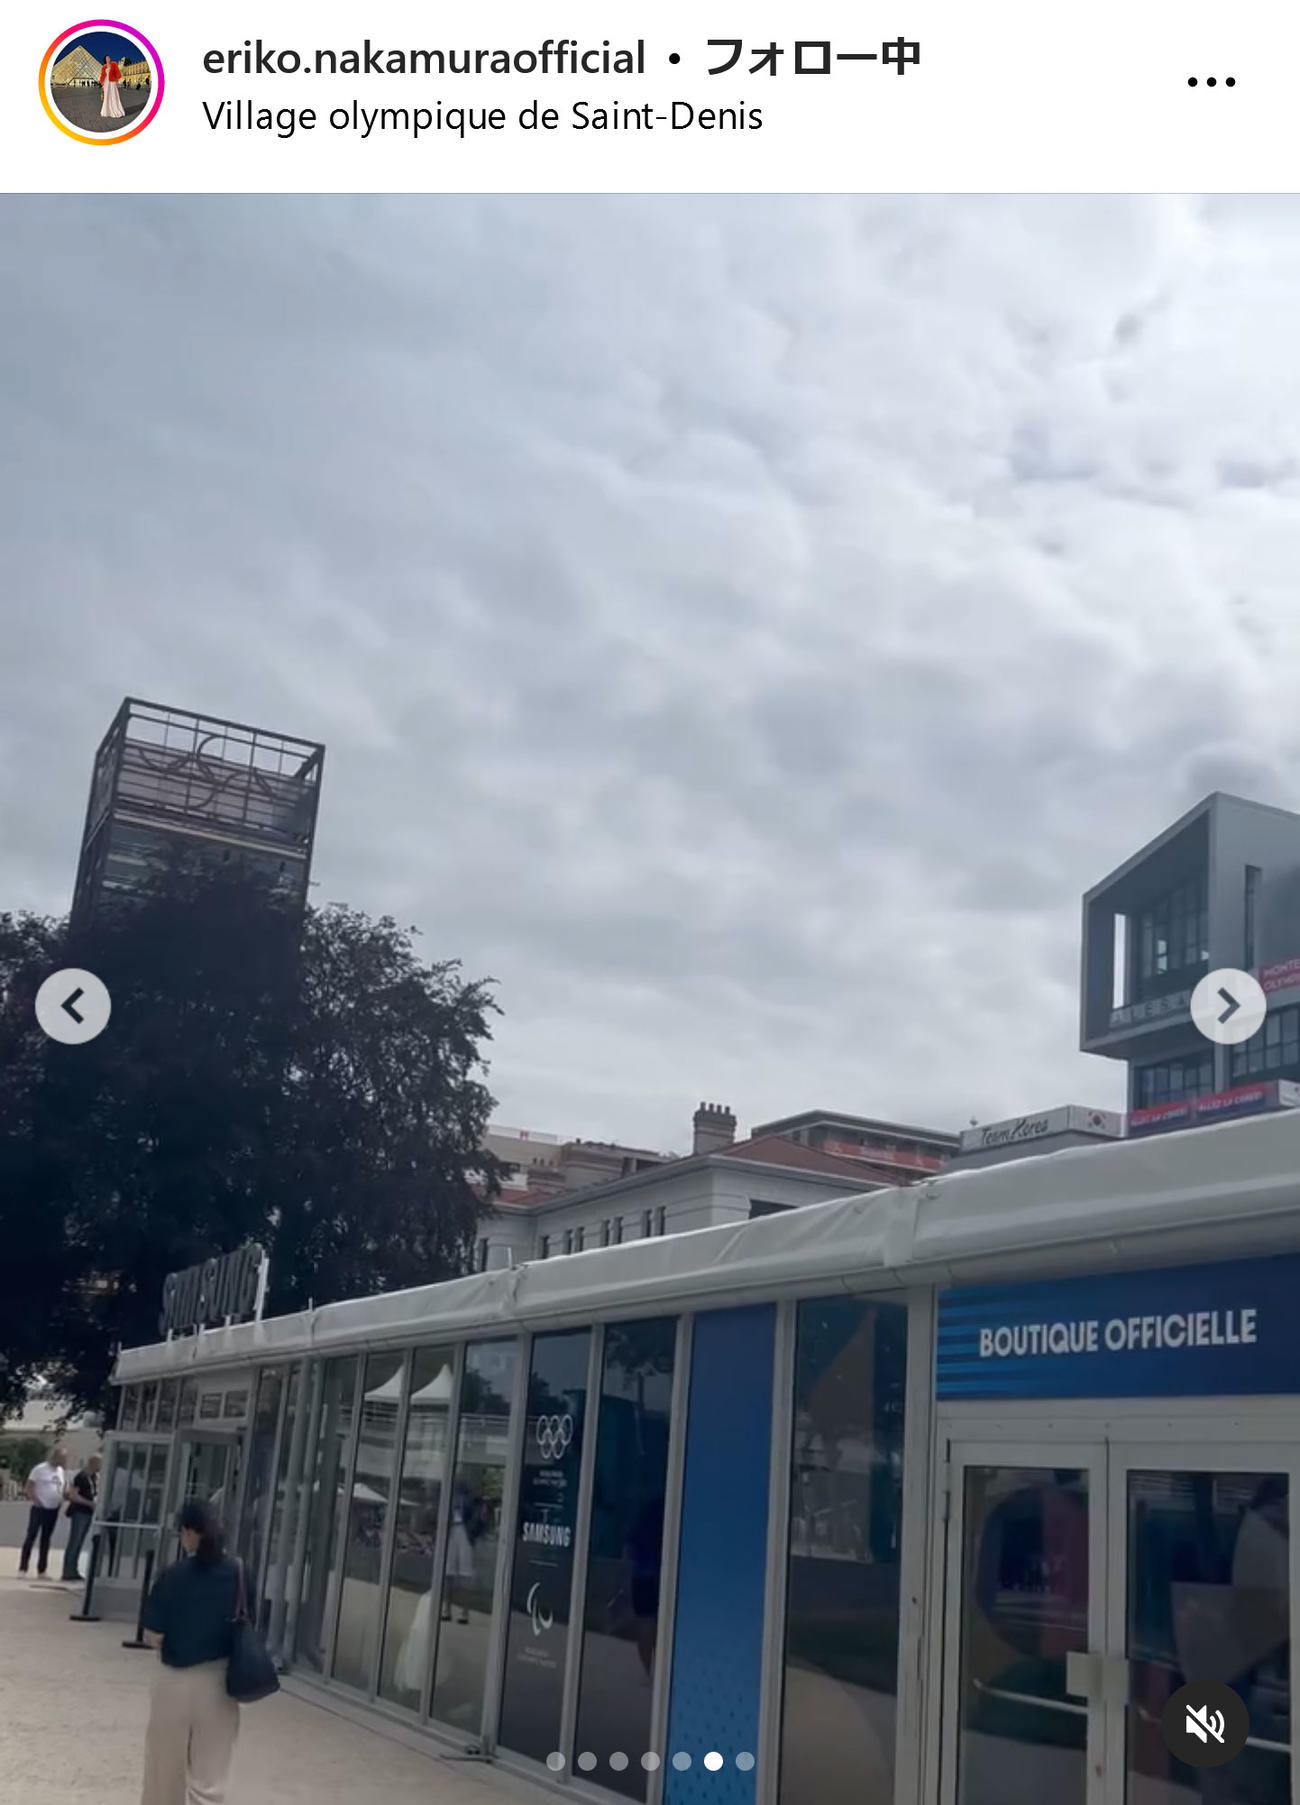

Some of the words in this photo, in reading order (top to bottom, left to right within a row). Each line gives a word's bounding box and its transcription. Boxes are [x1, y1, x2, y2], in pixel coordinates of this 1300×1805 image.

[982, 1126, 1010, 1145] Team
[979, 1320, 1099, 1358] BOUTIQUE
[1104, 1308, 1257, 1351] OFFICIELLE
[522, 1521, 571, 1547] SAMSUNG
